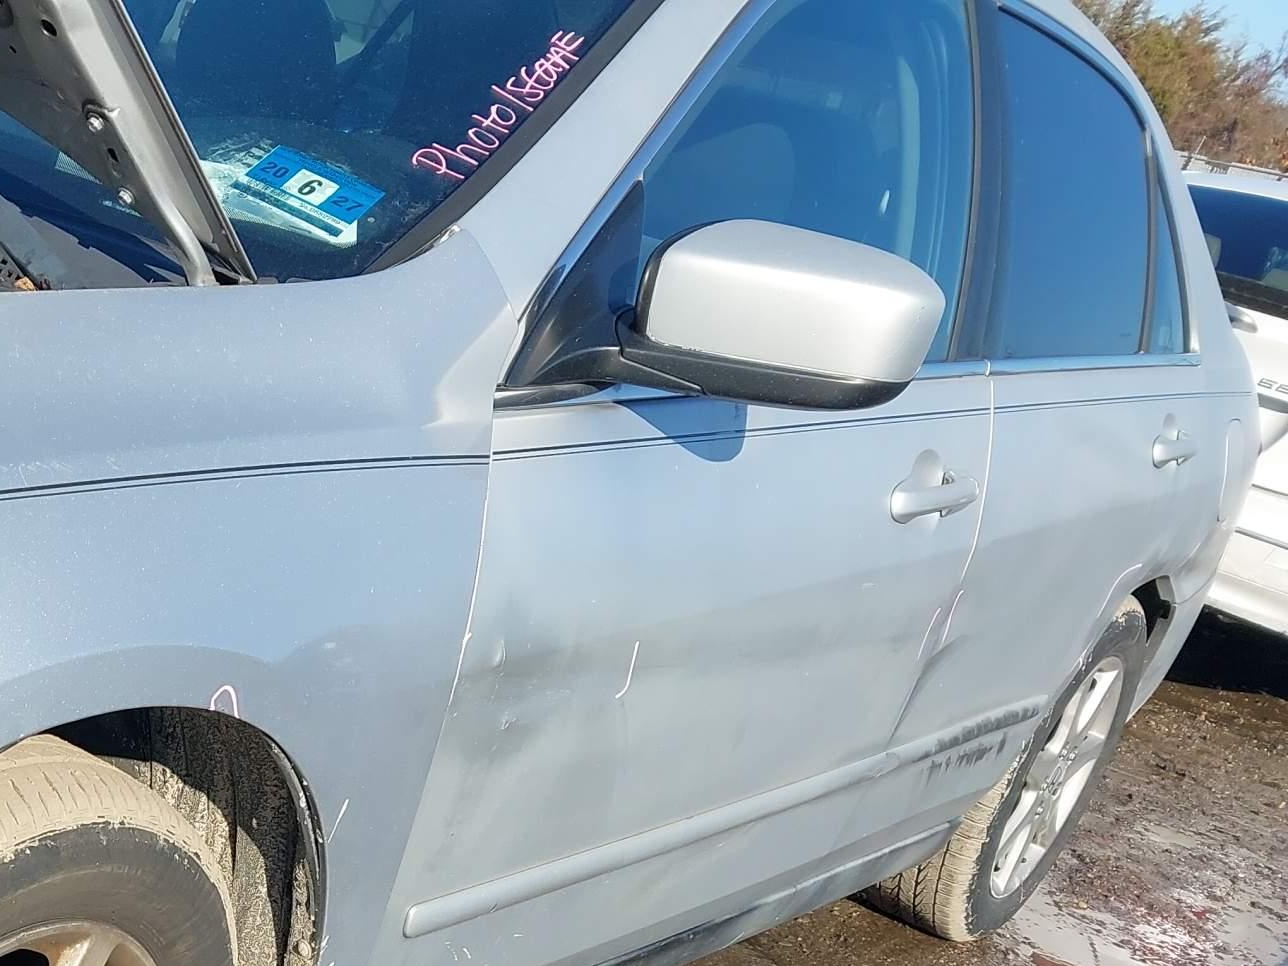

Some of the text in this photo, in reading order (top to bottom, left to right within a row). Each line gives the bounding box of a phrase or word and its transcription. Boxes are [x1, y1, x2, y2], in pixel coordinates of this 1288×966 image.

[261, 161, 290, 179] 20
[297, 179, 323, 196] 6
[331, 196, 362, 211] 27
